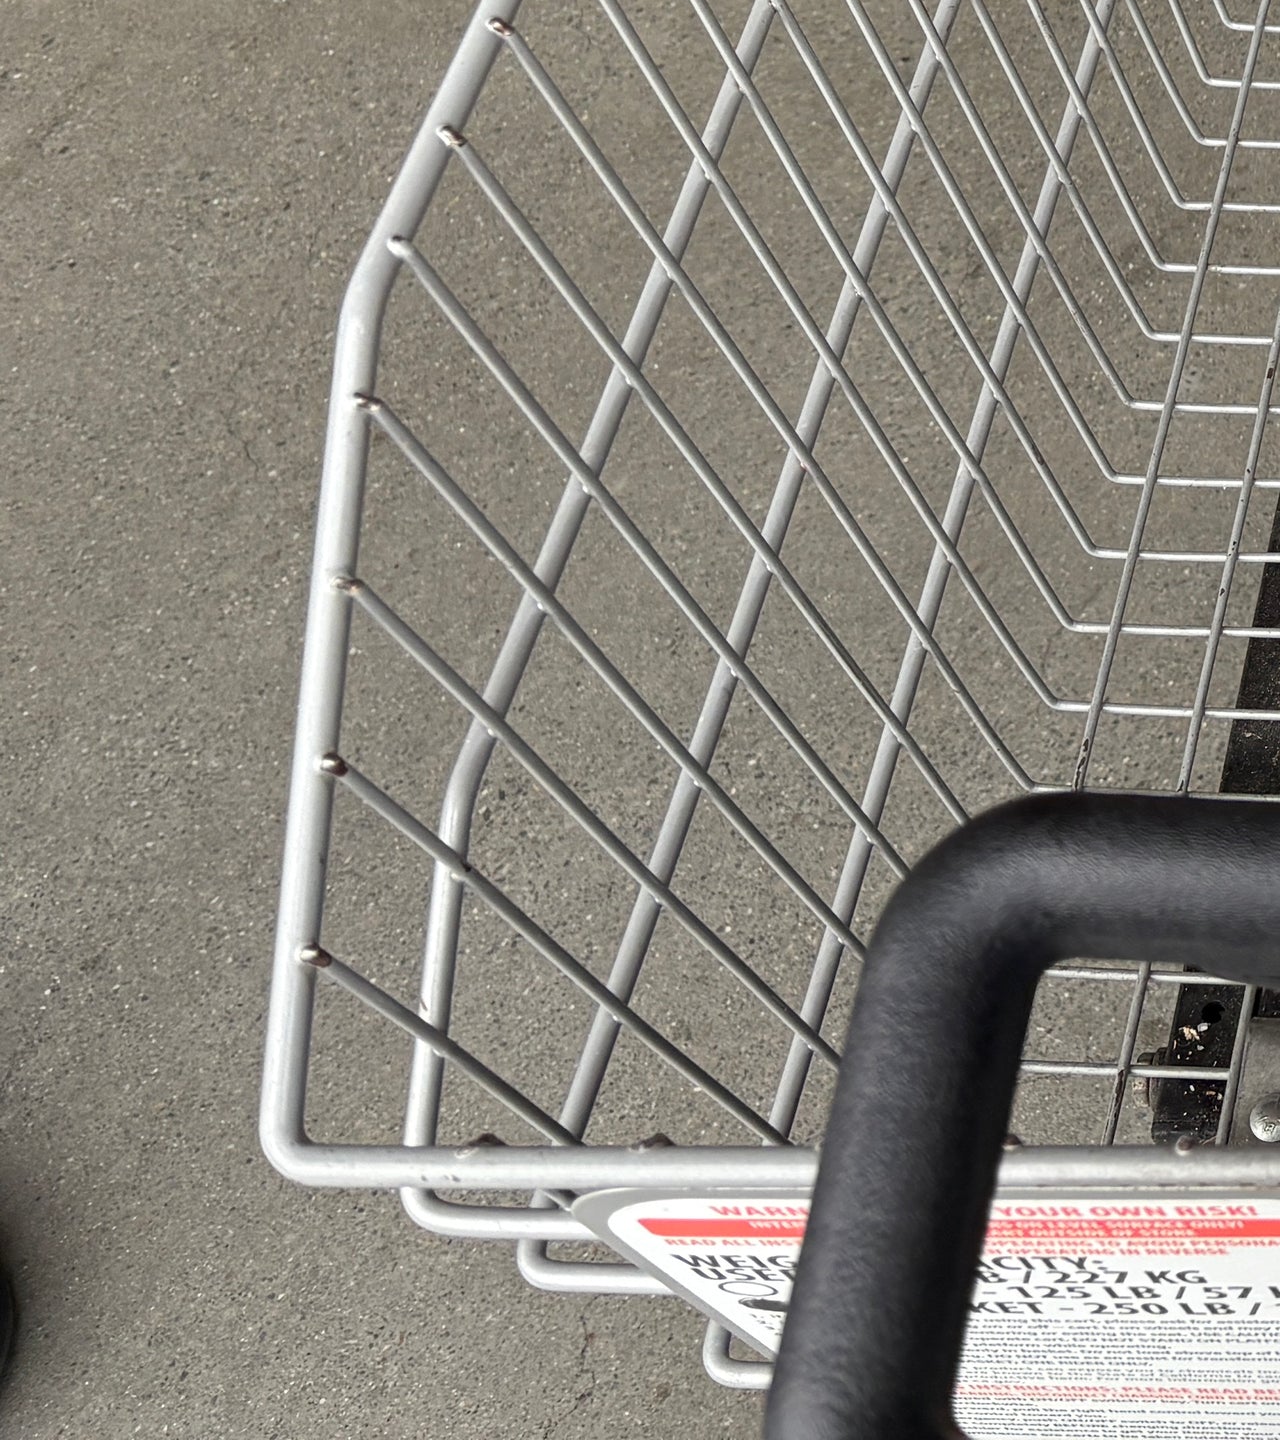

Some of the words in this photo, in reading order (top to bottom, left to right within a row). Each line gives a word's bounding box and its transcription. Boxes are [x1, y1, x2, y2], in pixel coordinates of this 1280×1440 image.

[995, 1206, 1083, 1217] YOUR
[1089, 1206, 1167, 1217] OWN
[1174, 1205, 1258, 1216] RISK!
[1046, 1271, 1128, 1284] 227
[1144, 1270, 1208, 1284] KG
[1007, 1286, 1092, 1298] 125
[1102, 1286, 1162, 1299] LB
[1203, 1286, 1253, 1299] 57
[1083, 1302, 1169, 1315] 250
[1178, 1302, 1236, 1315] LB
